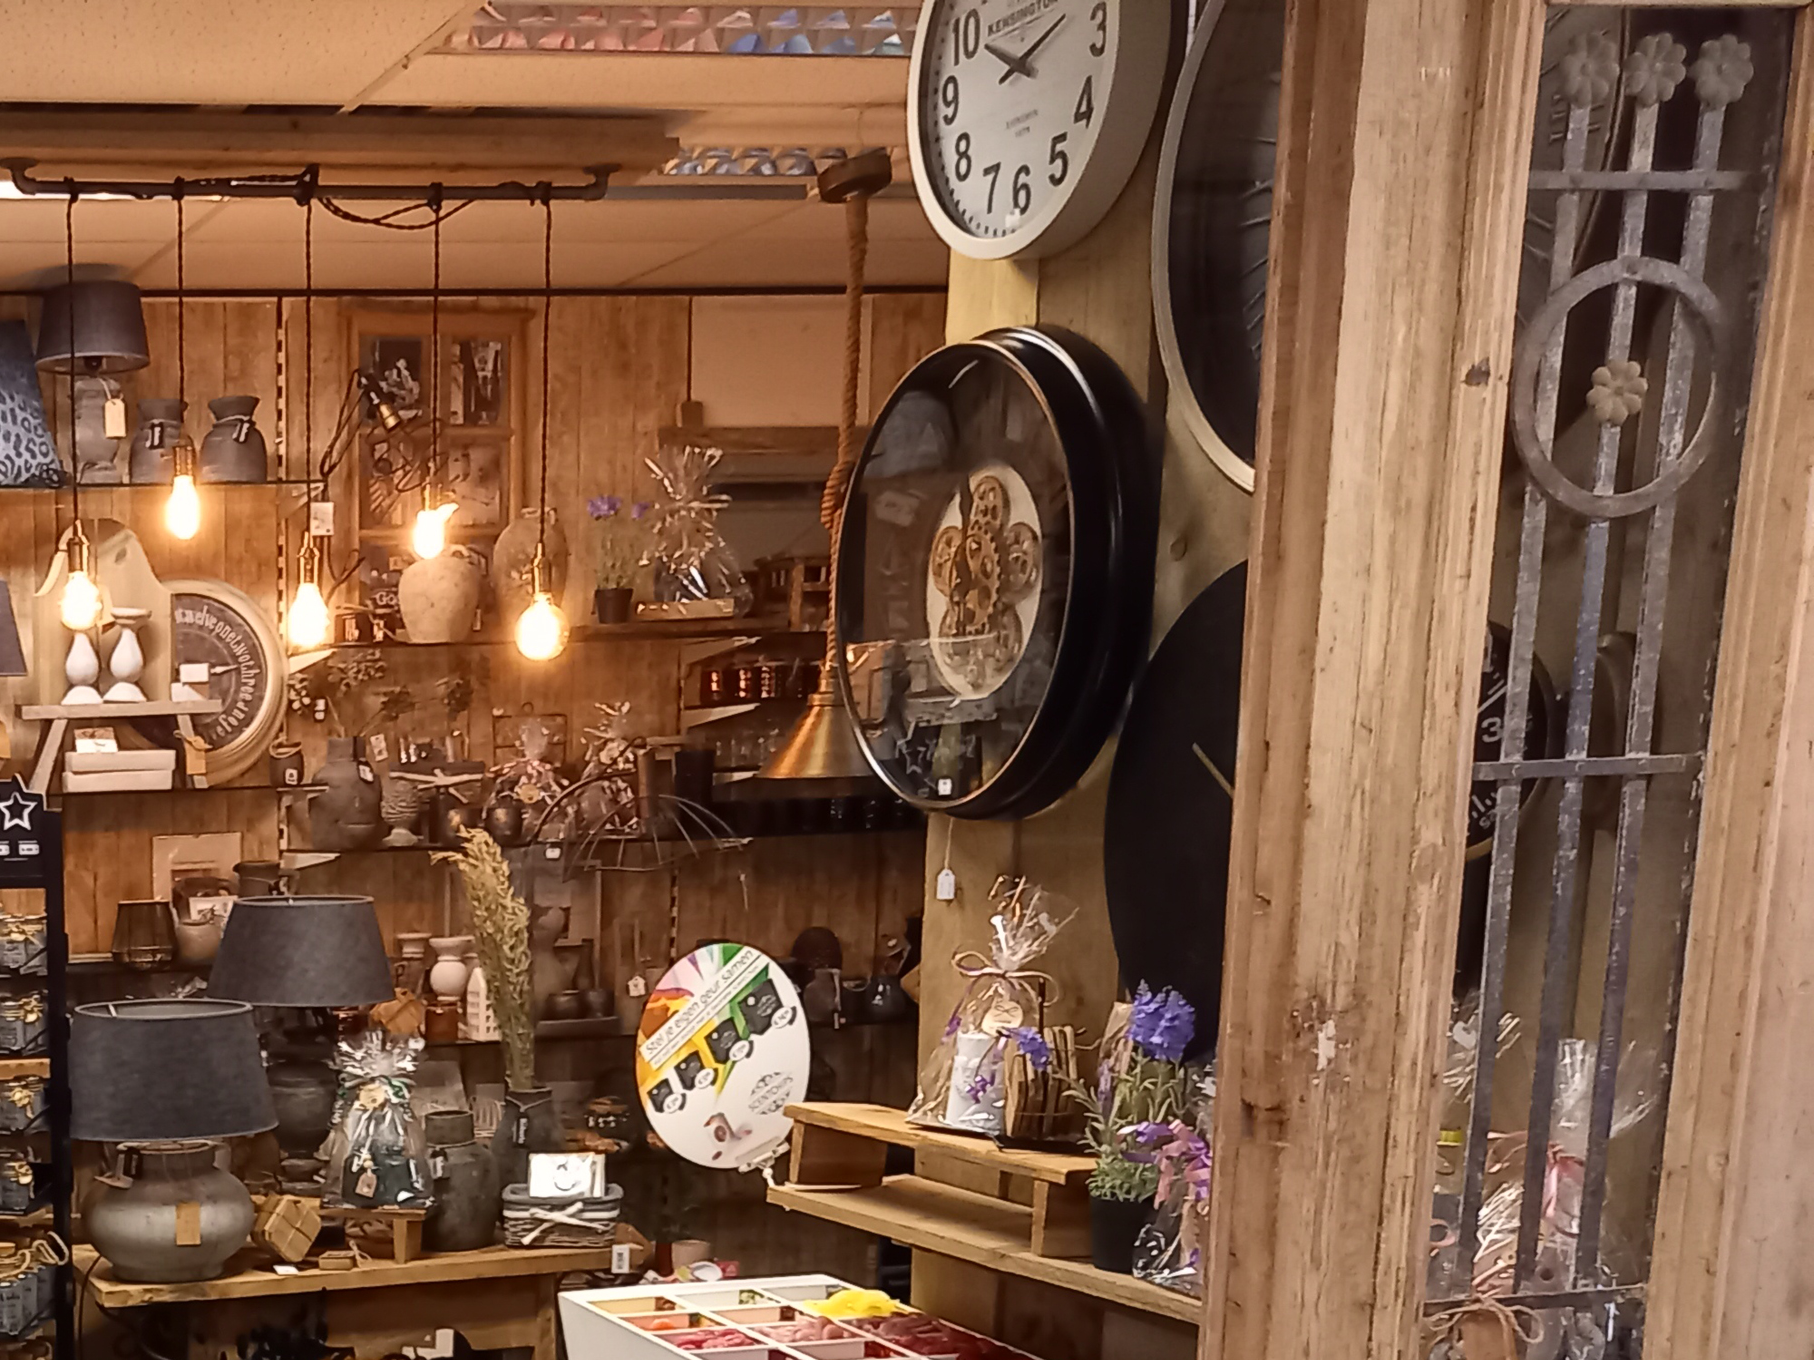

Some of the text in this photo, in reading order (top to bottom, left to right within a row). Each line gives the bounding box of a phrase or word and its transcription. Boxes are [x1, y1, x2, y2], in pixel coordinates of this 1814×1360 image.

[951, 8, 982, 67] 10
[1088, 1, 1107, 57] 3
[941, 74, 960, 127] 9
[1073, 74, 1095, 129] 4
[954, 131, 972, 182] 8
[1048, 131, 1069, 187] 5
[982, 162, 1002, 216] 7
[1012, 164, 1032, 216] 6
